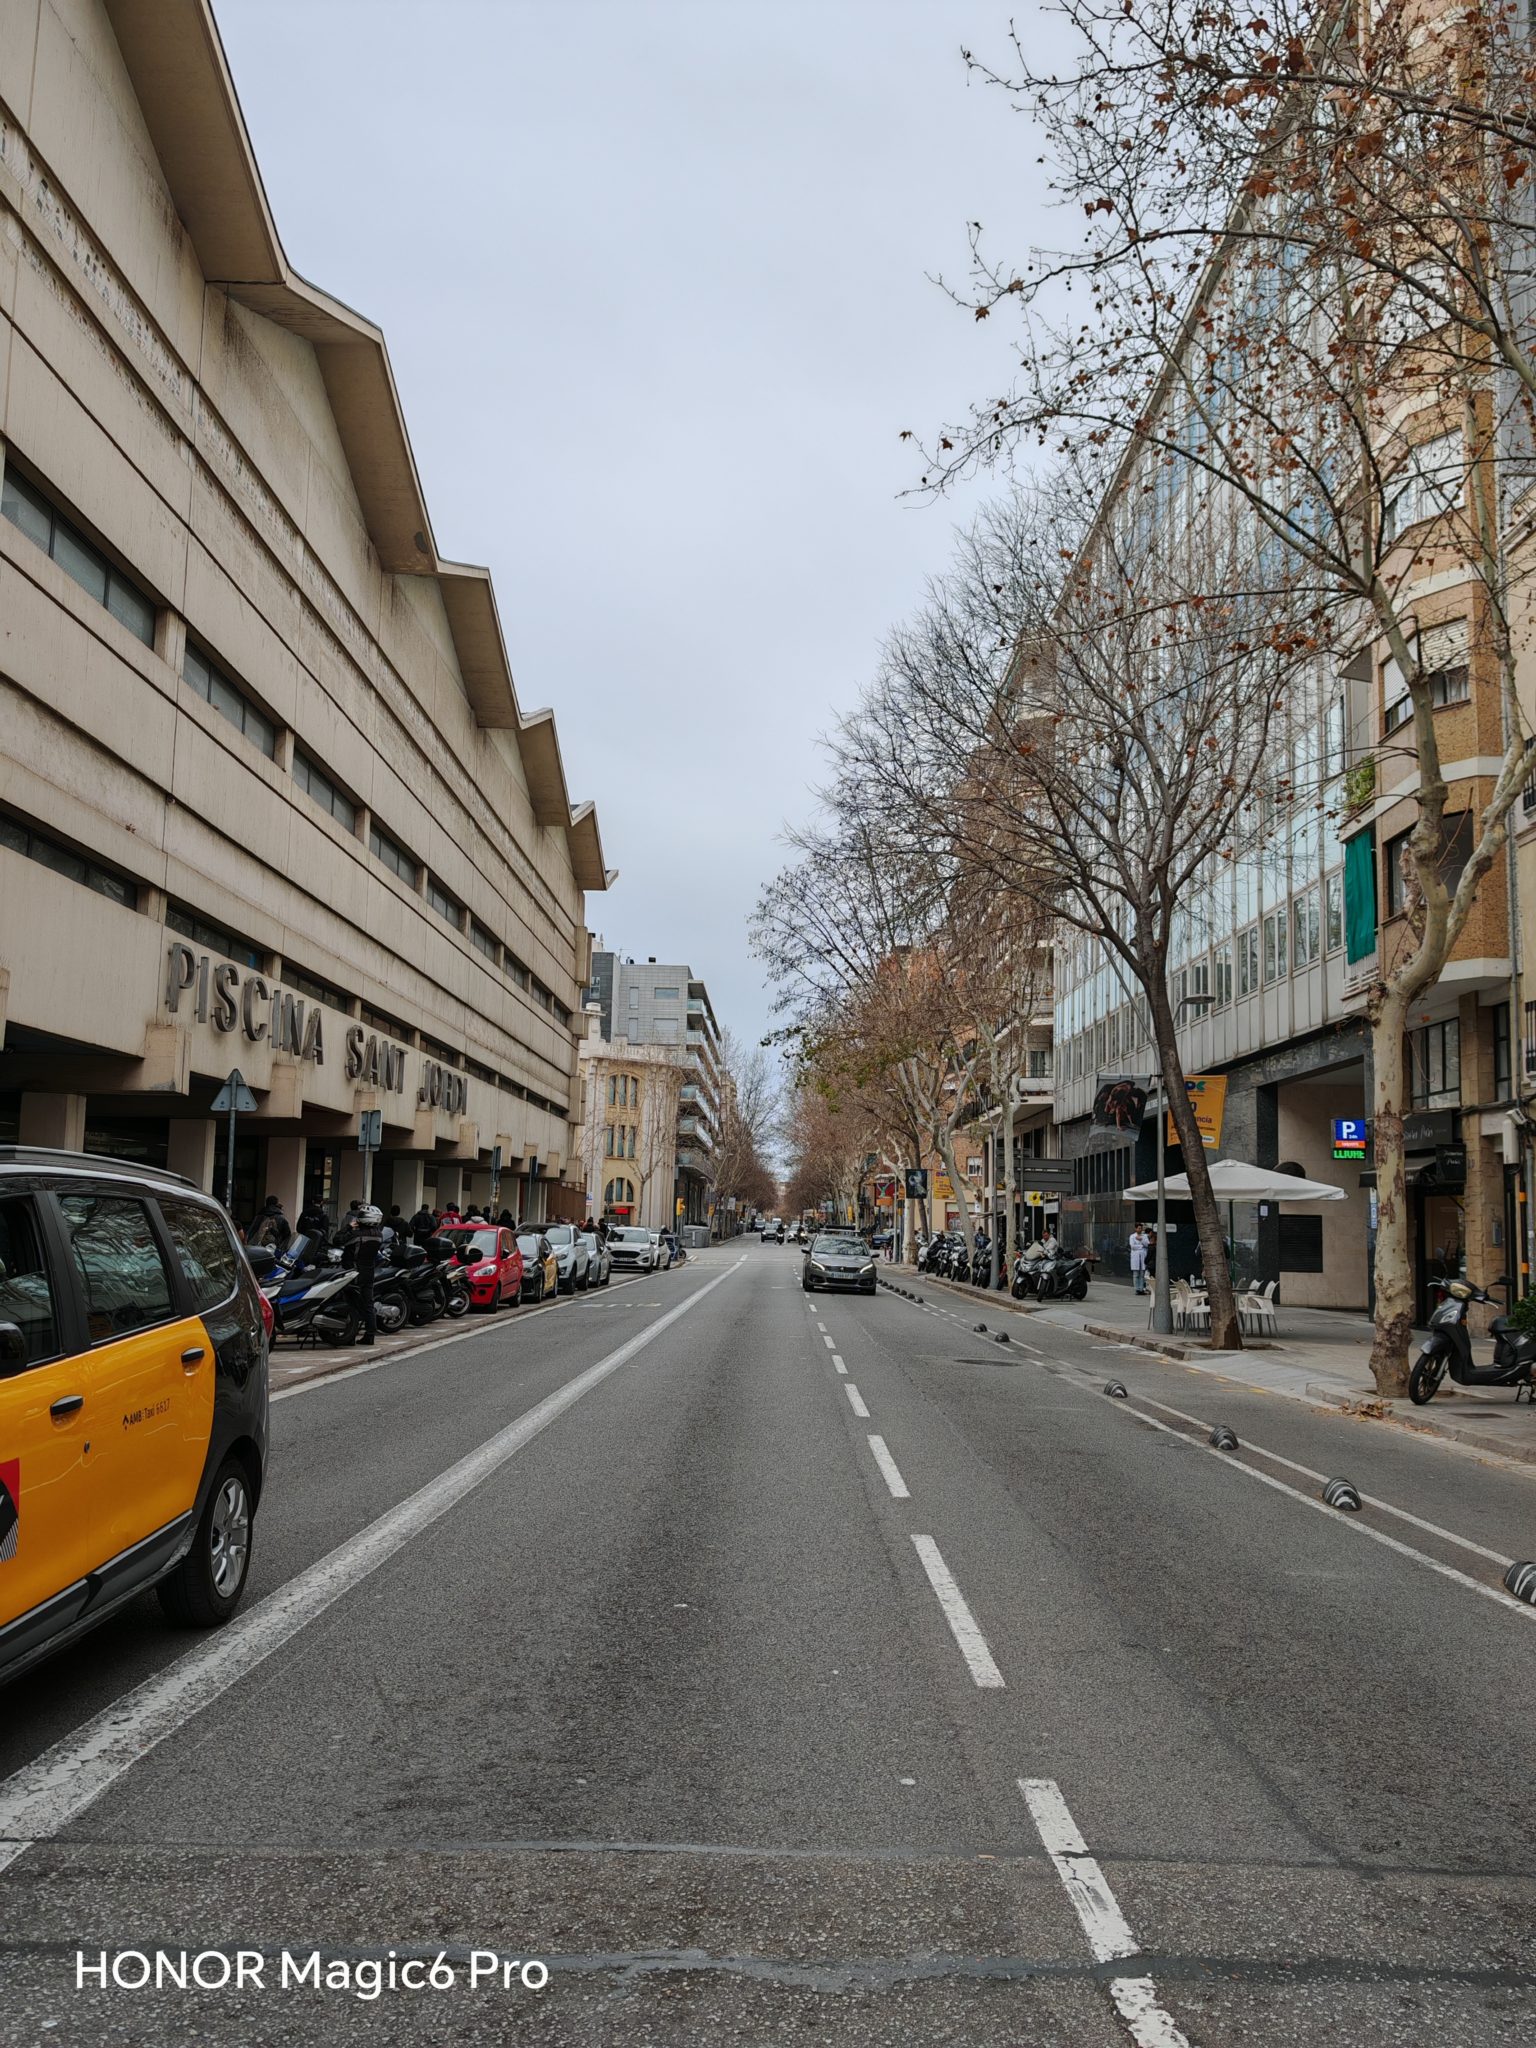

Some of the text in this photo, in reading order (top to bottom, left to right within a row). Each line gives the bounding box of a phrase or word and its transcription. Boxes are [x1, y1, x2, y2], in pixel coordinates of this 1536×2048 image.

[166, 942, 468, 1115] PISCINA SANT JORDI
[1342, 1121, 1356, 1139] P
